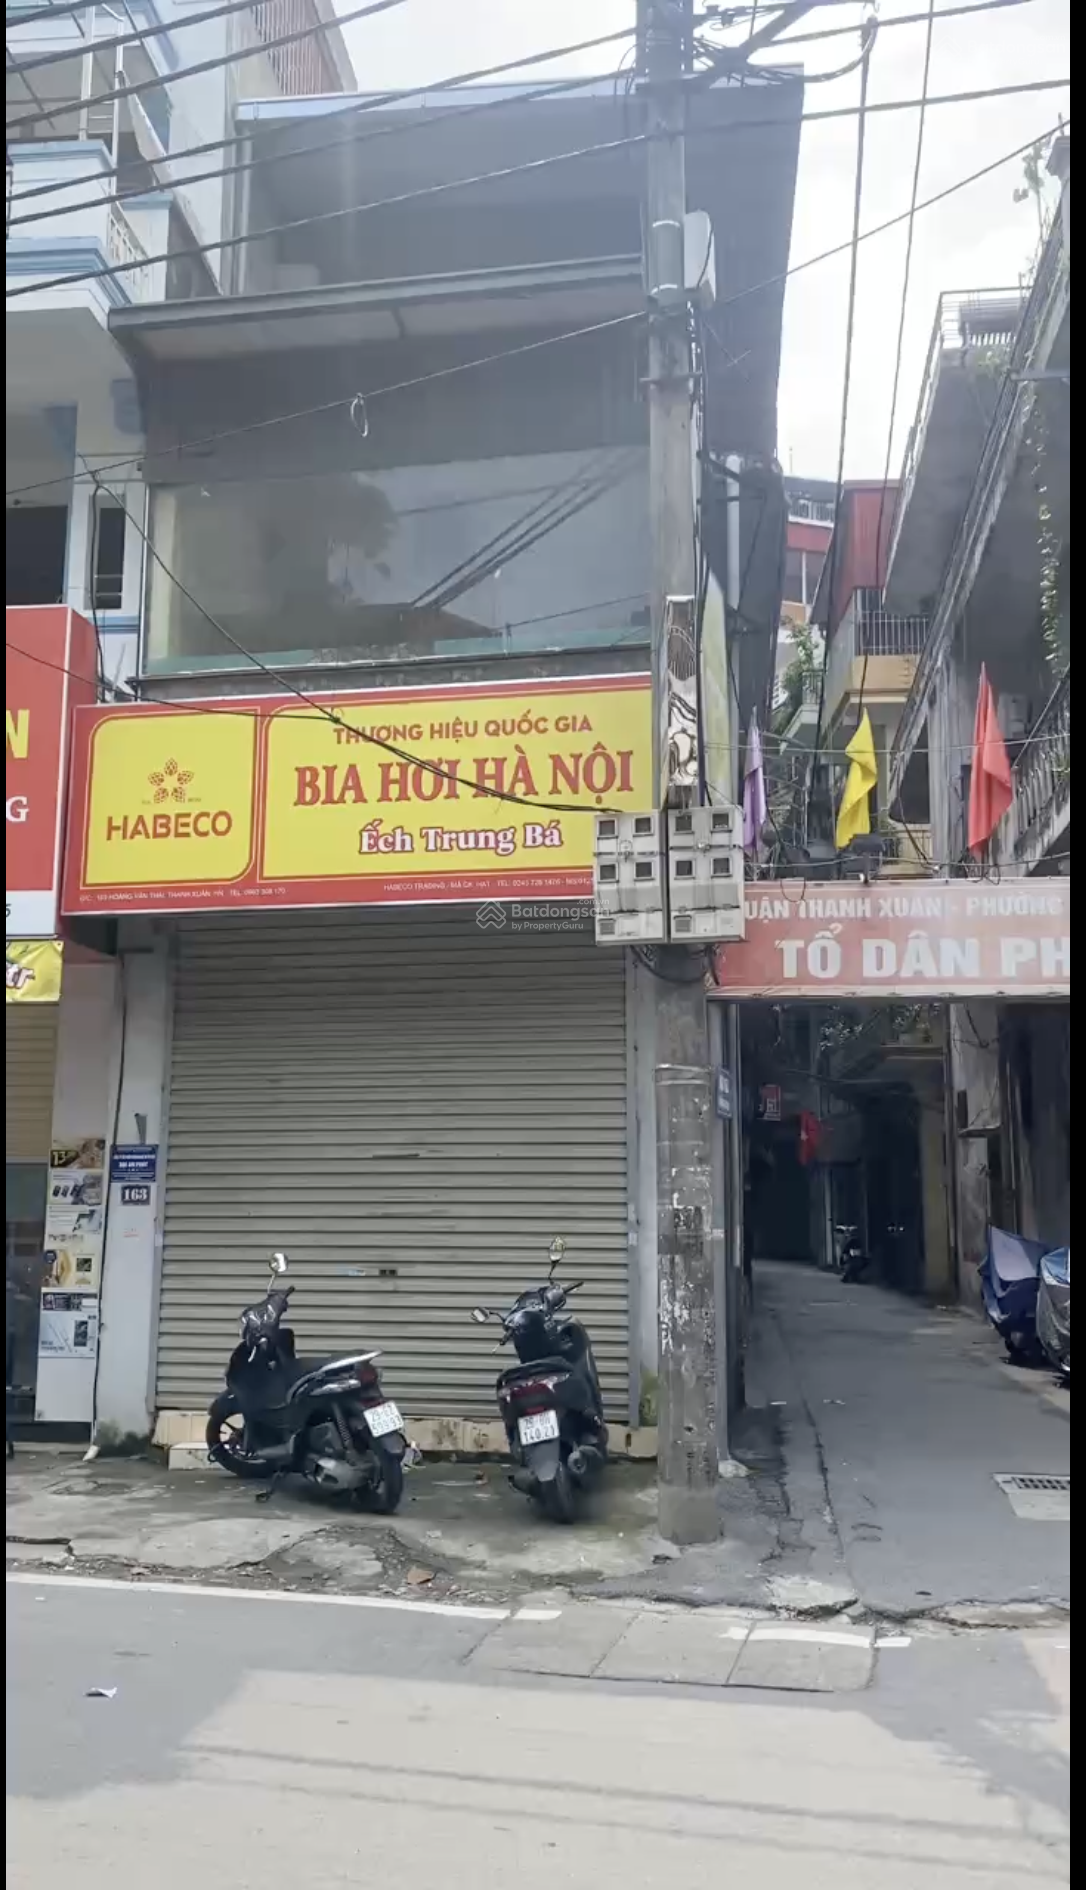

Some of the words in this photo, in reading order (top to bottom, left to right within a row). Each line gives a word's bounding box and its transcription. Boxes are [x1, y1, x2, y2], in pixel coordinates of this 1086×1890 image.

[333, 723, 423, 745] THƯƠNG
[430, 717, 477, 743] HIỆU
[485, 710, 549, 736] QUỐC
[555, 715, 592, 732] GIA
[294, 764, 367, 806] BIA
[378, 758, 460, 803] HƠI
[472, 745, 538, 799] HÀ
[549, 742, 634, 804] NỘI
[106, 811, 232, 841] HABECO
[358, 819, 413, 855] Ếch
[420, 825, 516, 856] Trung
[524, 821, 563, 848] Bá
[745, 897, 789, 923] UẬN
[799, 898, 871, 918] THANH
[775, 923, 842, 979] TỔ
[862, 930, 981, 978] DÂN
[124, 1188, 147, 1201] 163
